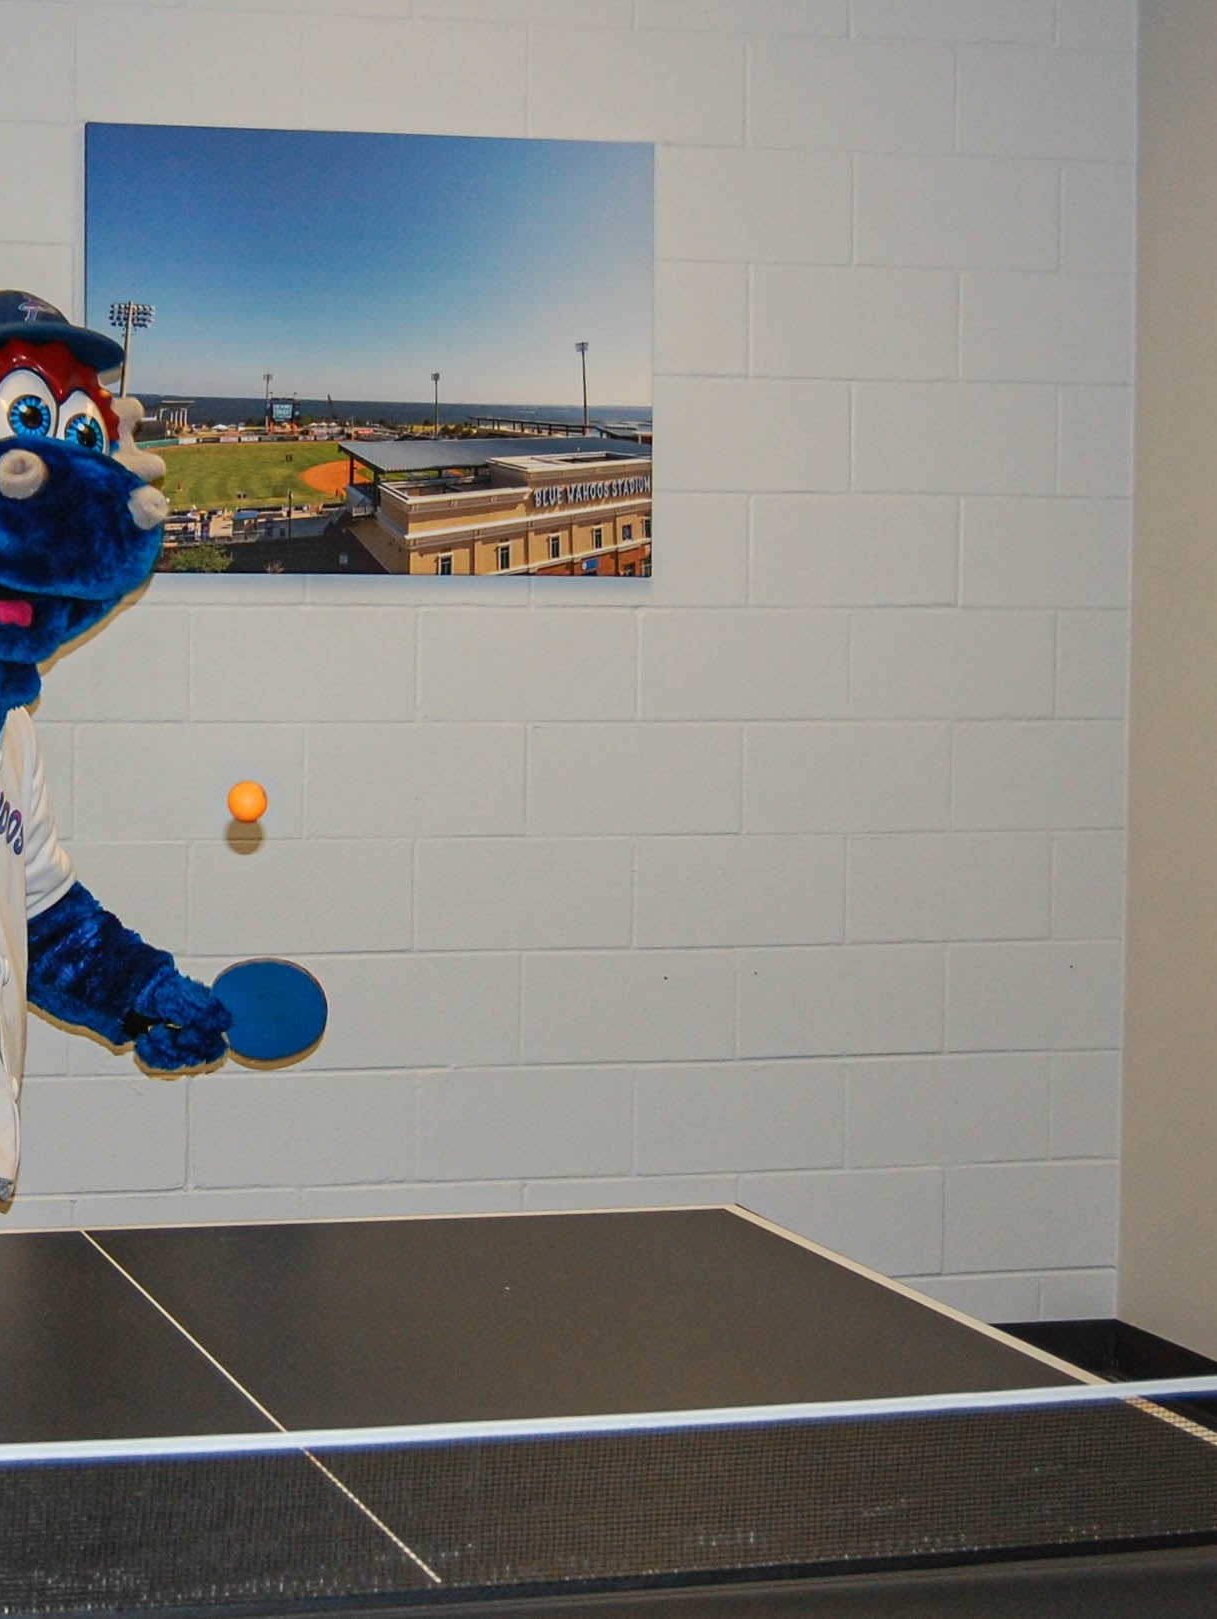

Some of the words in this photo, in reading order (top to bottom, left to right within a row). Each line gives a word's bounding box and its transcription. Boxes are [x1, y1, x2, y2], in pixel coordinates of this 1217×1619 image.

[534, 487, 563, 508] BLUE
[567, 481, 610, 504] WAHOOS
[611, 475, 651, 498] STADIUM
